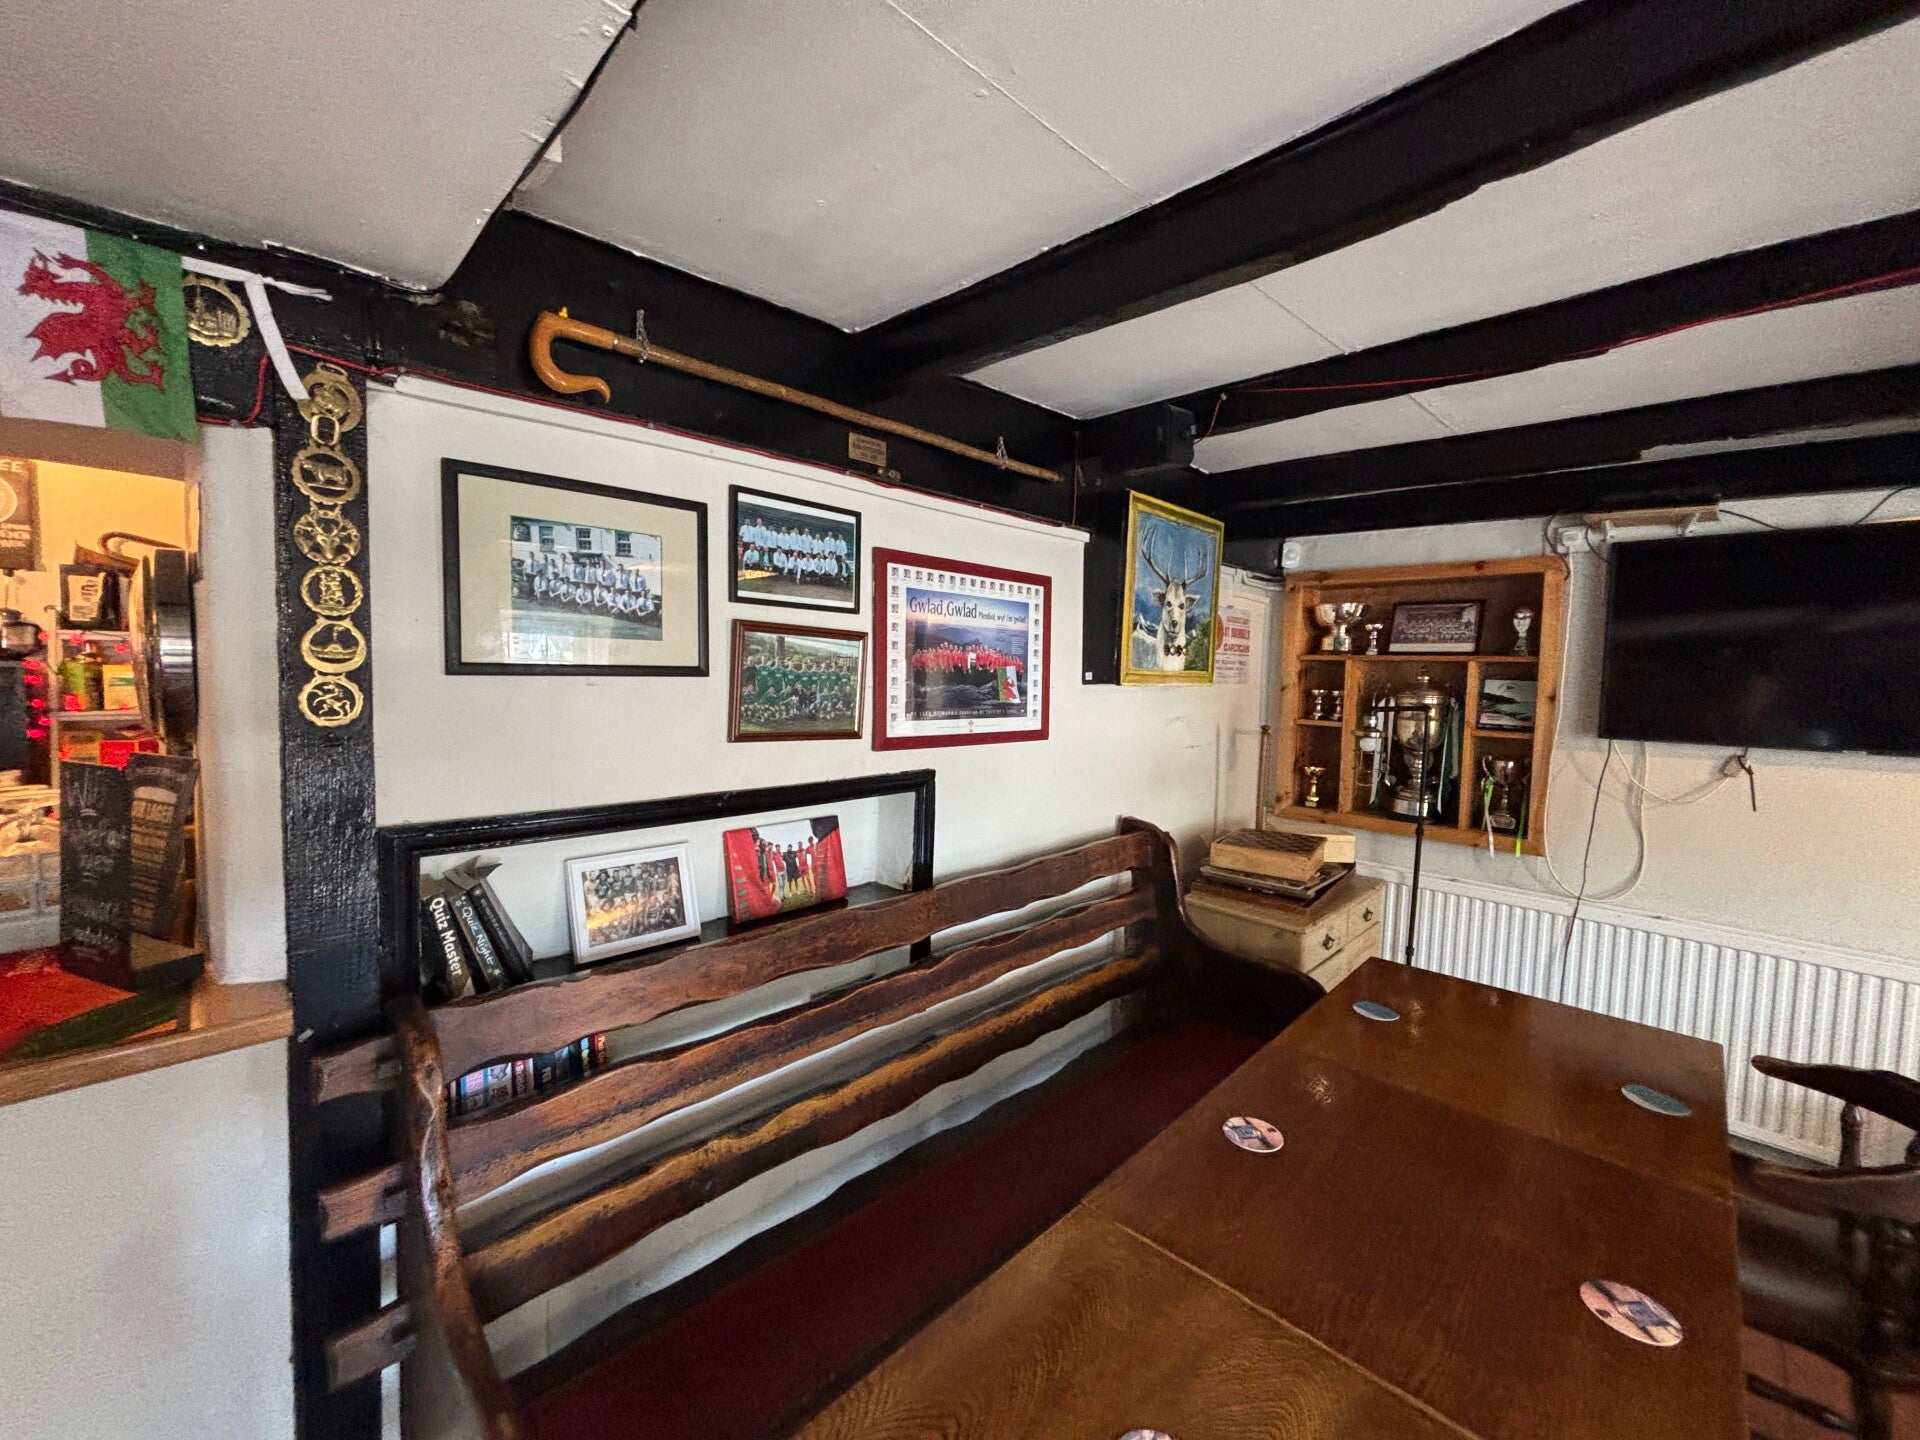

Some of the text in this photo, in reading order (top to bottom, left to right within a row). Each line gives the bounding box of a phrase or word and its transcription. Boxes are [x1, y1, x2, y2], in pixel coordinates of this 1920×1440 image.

[946, 600, 977, 619] Gwlad
[430, 897, 463, 976] Quiz Master
[462, 906, 479, 935] Quiz
[475, 934, 494, 966] Night
